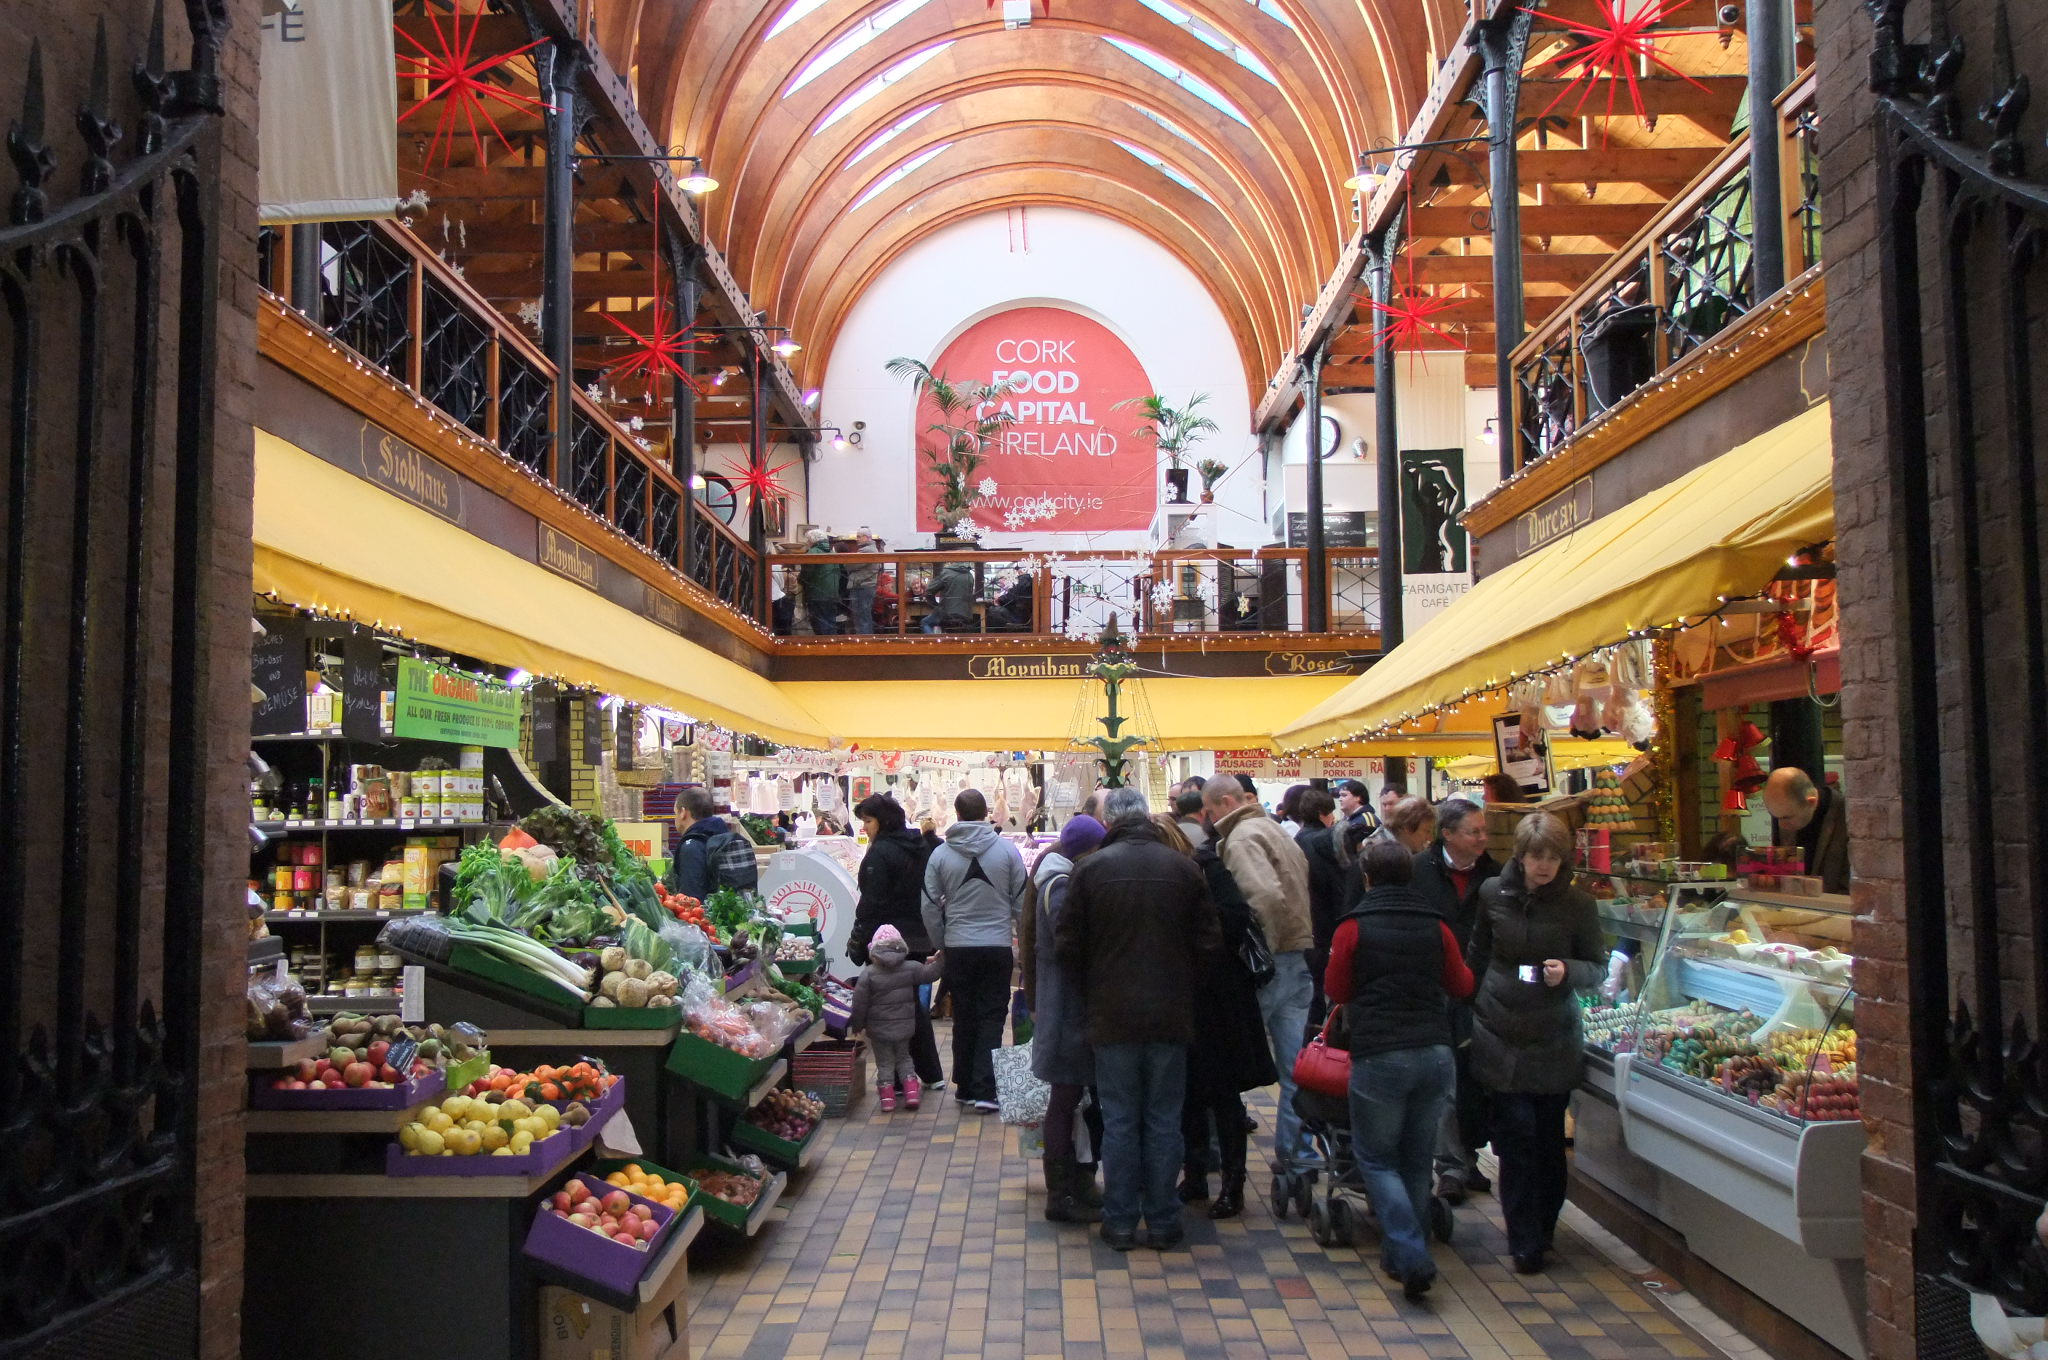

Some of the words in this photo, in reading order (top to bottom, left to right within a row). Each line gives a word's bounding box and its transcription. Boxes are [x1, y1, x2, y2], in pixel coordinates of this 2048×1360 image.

[996, 339, 1076, 364] CORK
[992, 370, 1080, 394] FOOD
[976, 401, 1095, 425] CAPITAL
[1000, 432, 1118, 456] IRELAND
[1527, 498, 1578, 546] Durcan
[544, 530, 593, 582] Moynihan
[1402, 583, 1469, 595] FARMGATE
[984, 656, 1080, 678] Moynihan
[408, 667, 429, 693] THE
[432, 673, 479, 704] ORGANIC
[407, 705, 418, 718] ALL
[420, 707, 432, 721] OUR
[434, 710, 451, 724] FRESH
[1215, 759, 1264, 768] SAUSAGES
[1276, 769, 1300, 777] HAM
[1277, 759, 1301, 768] LOIN
[1322, 760, 1354, 768] BODICE
[1323, 769, 1346, 777] PORK
[769, 880, 834, 910] MOYNIHANS
[553, 1314, 569, 1339] BIO
